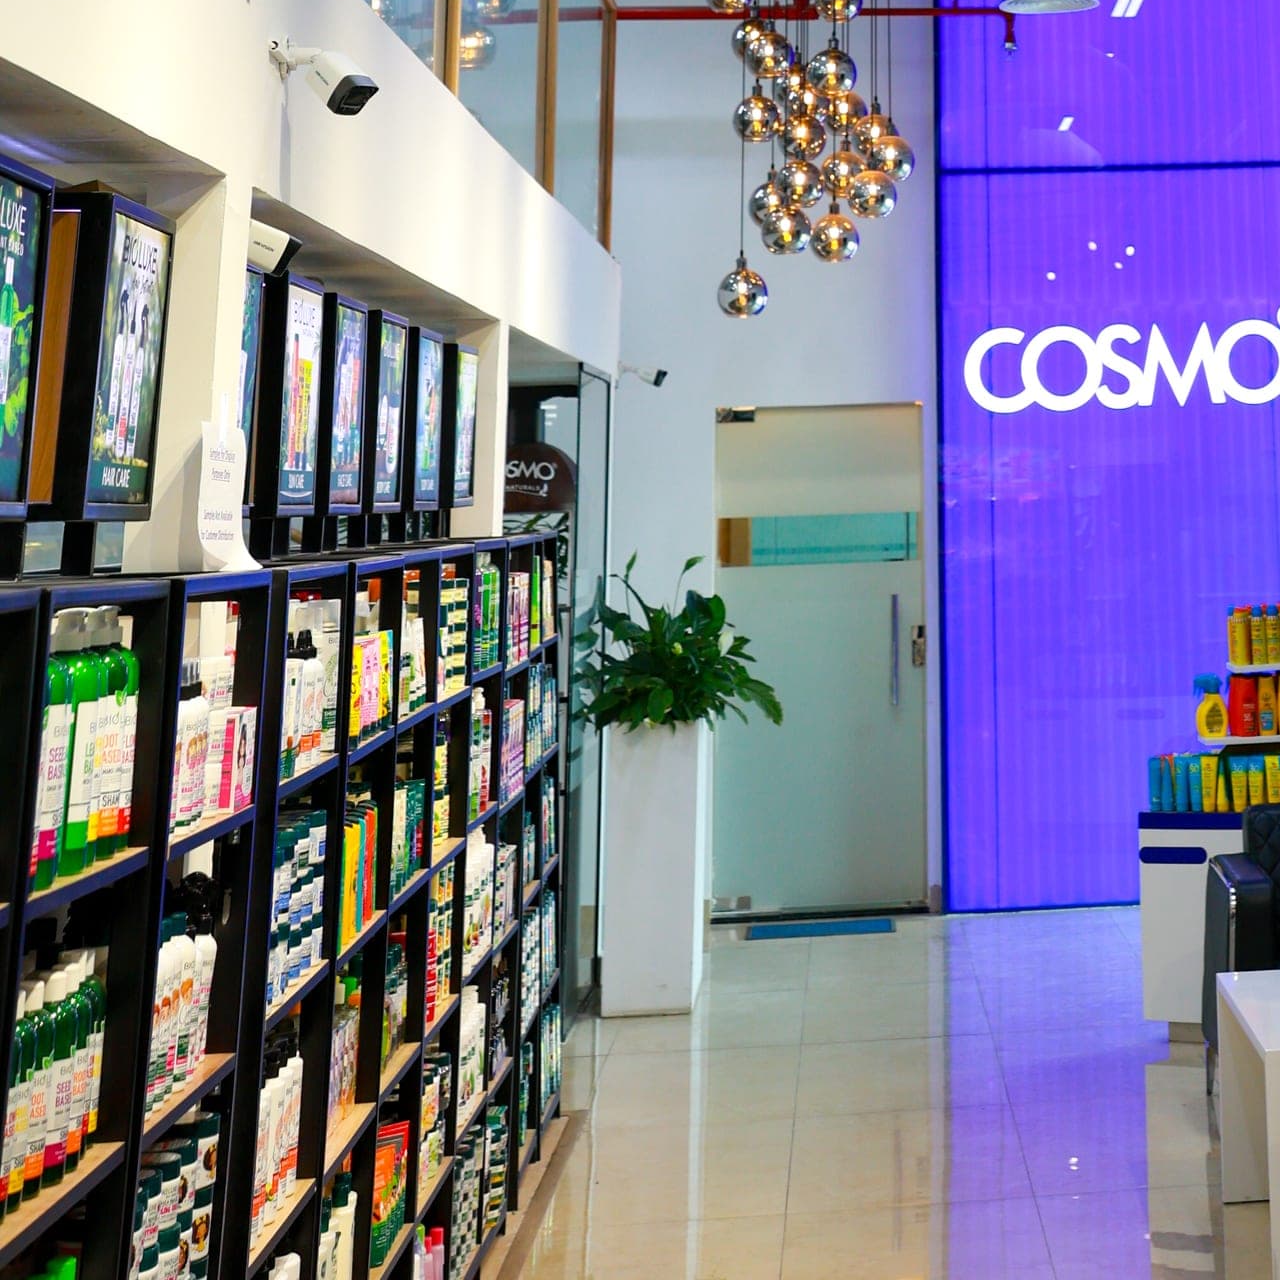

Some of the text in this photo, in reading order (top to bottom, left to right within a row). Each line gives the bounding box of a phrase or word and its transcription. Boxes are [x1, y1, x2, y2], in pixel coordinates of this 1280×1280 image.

[0, 196, 27, 237] LUXE
[101, 466, 131, 489] HAIR CARE
[505, 460, 556, 481] SMO
